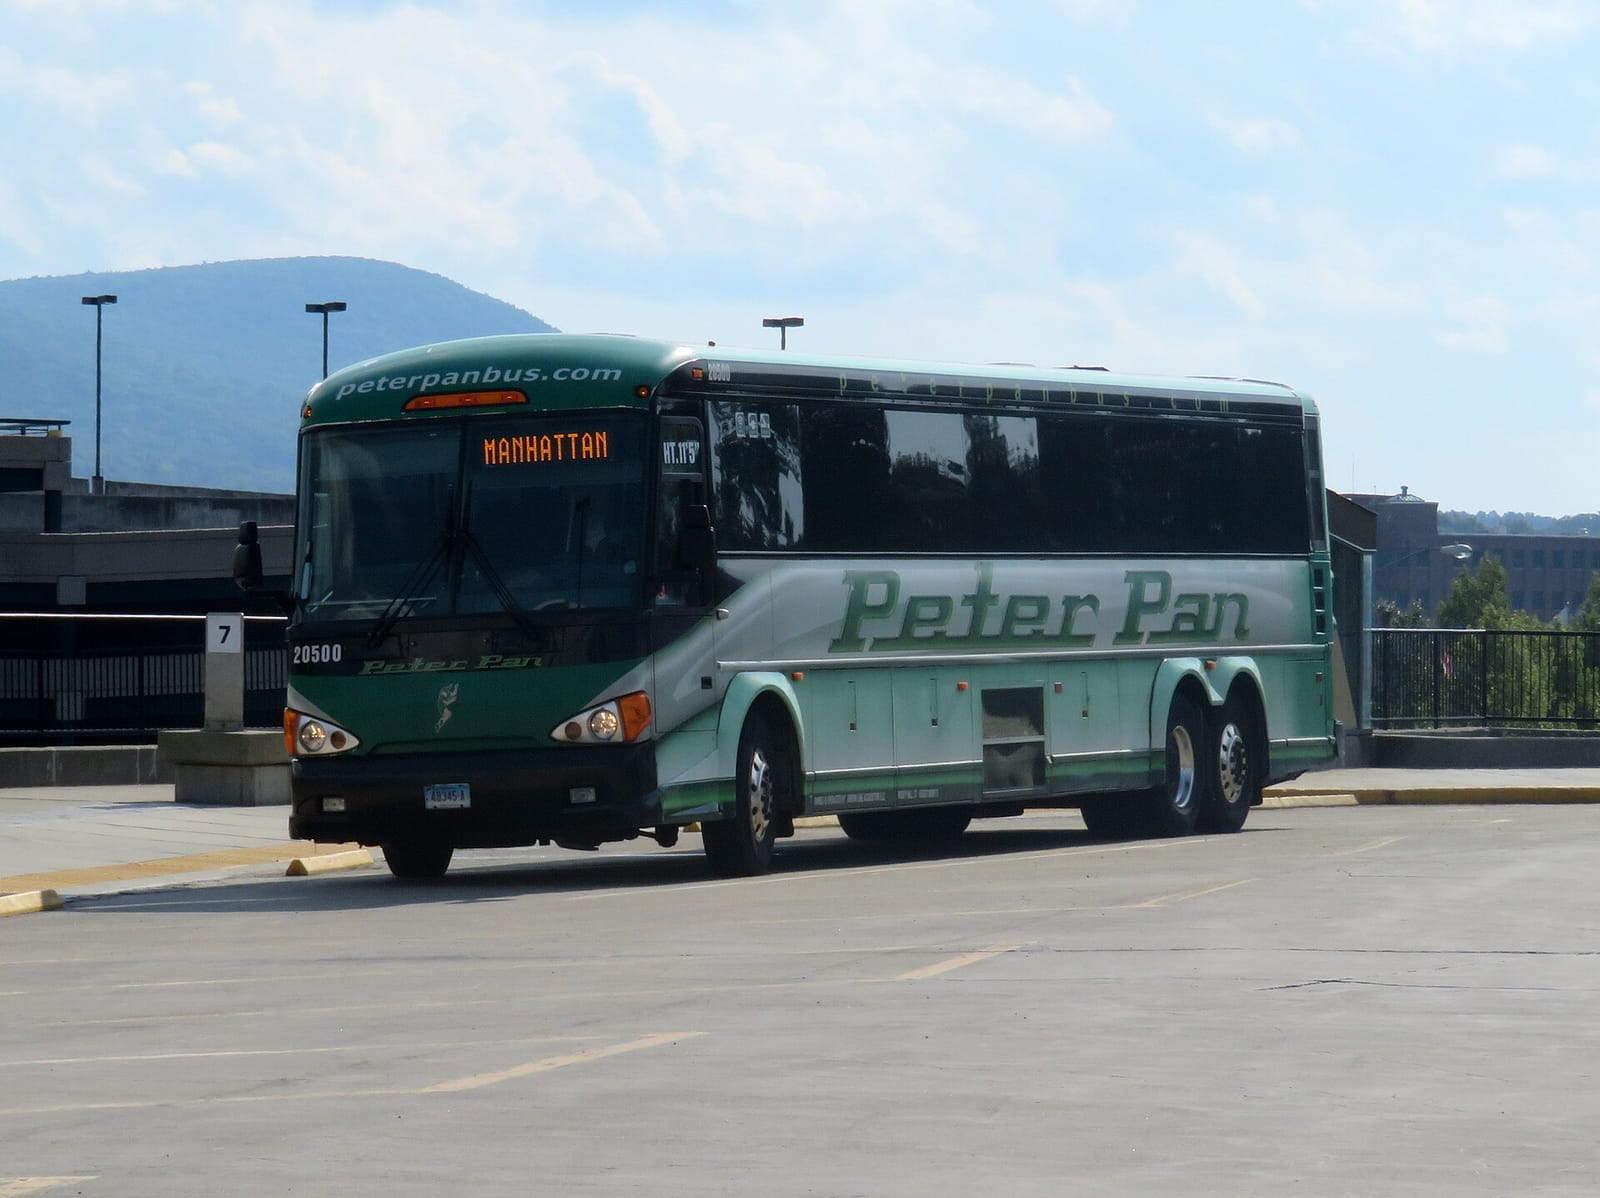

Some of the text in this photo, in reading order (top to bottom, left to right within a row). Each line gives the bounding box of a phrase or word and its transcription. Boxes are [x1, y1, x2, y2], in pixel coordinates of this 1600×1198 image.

[336, 365, 623, 400] peterpanbus.com
[483, 431, 608, 465] MANHATTAN
[828, 561, 1250, 653] Peter Pan
[218, 625, 232, 644] 7
[293, 643, 342, 664] 20500
[358, 654, 543, 675] Peter Pan
